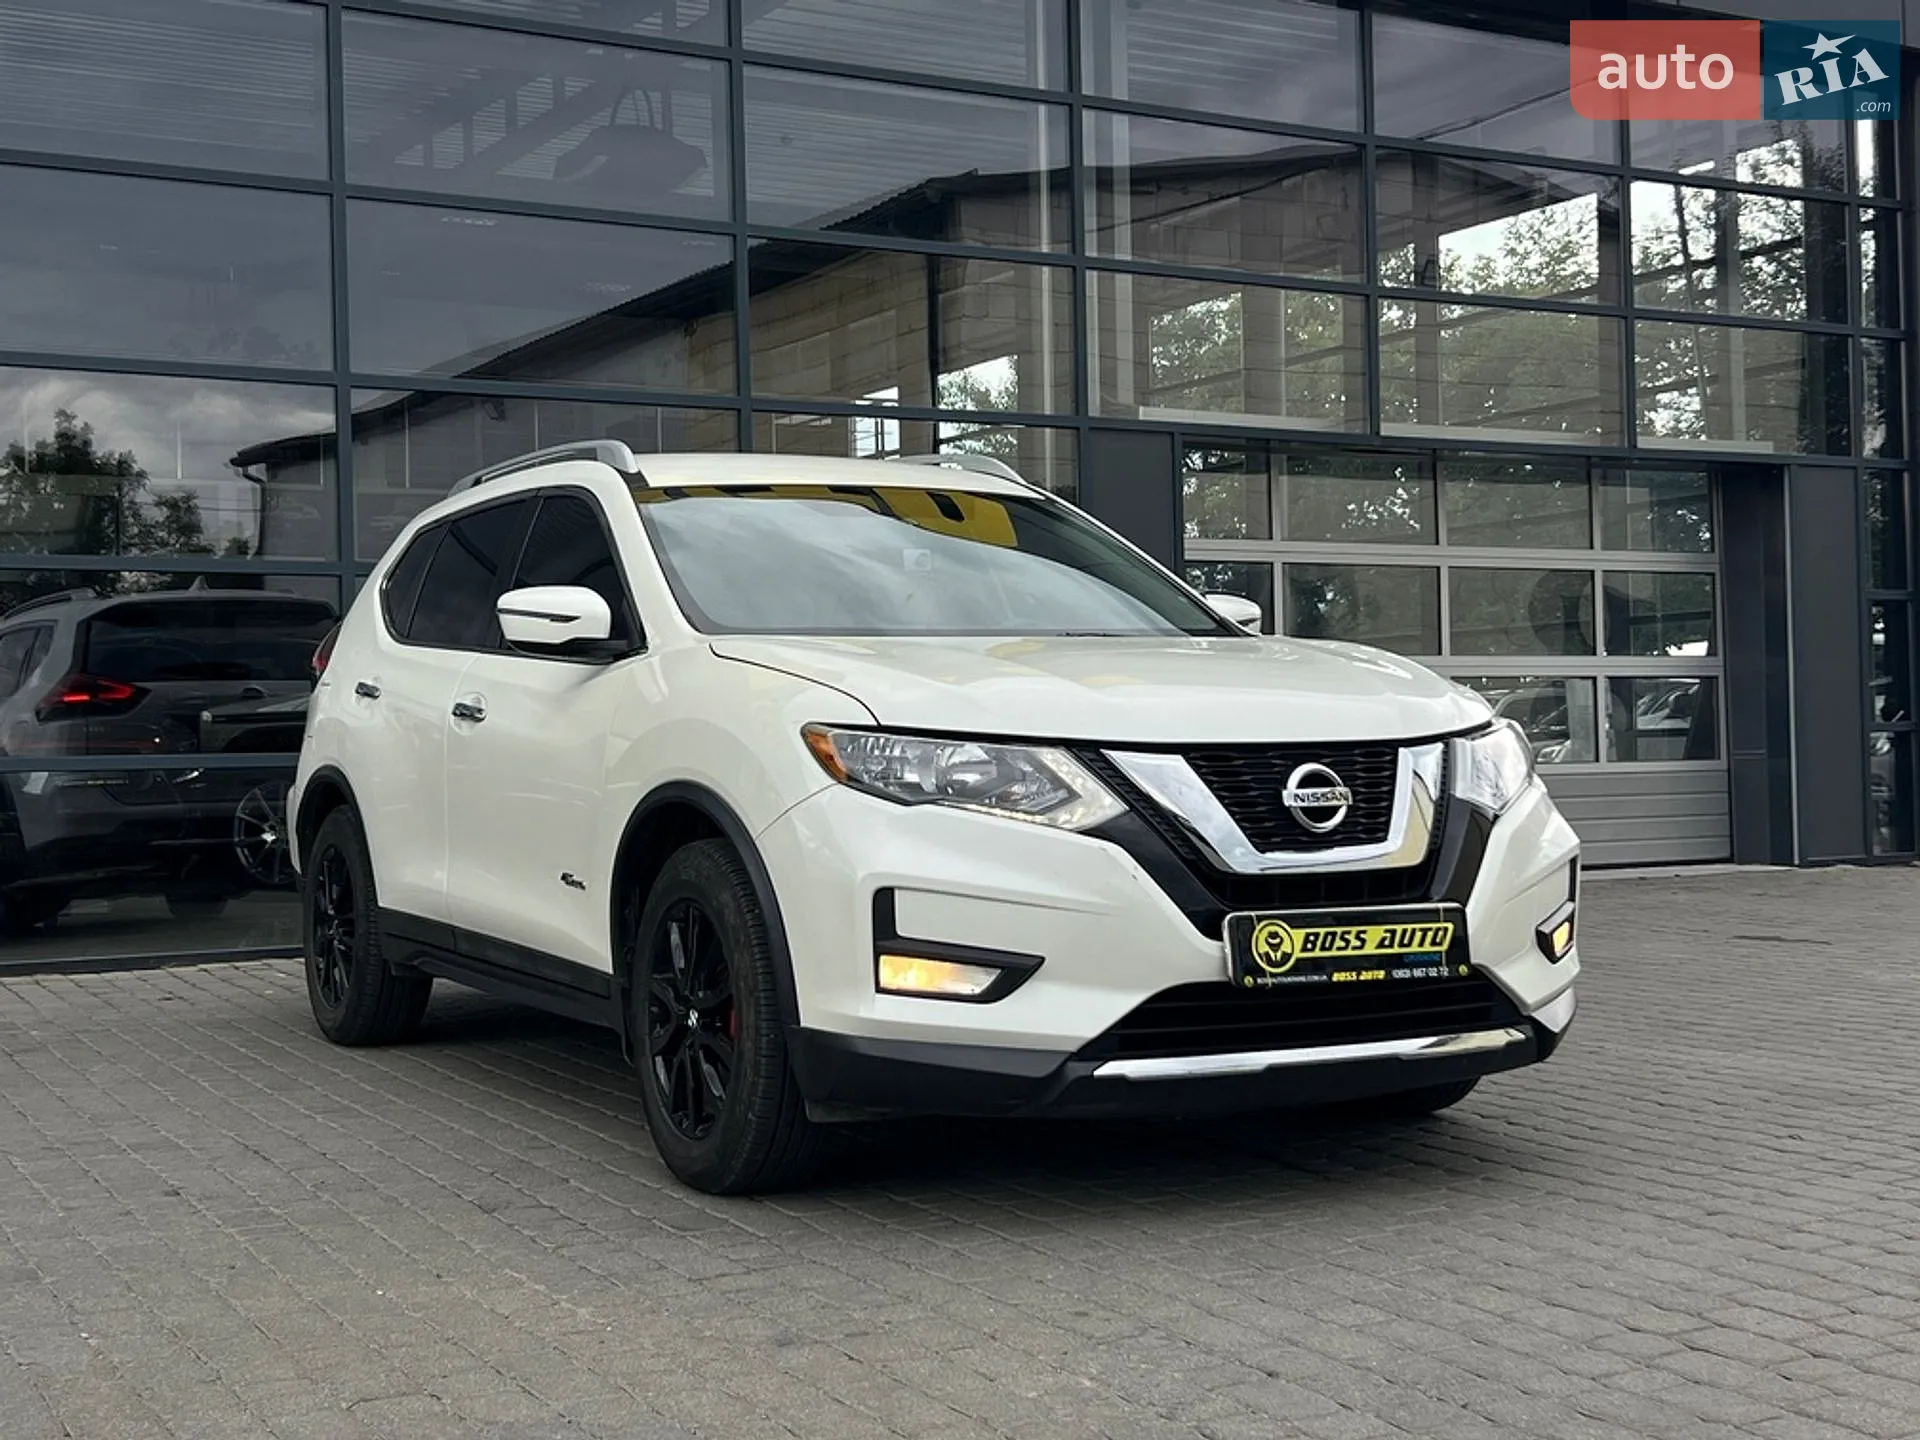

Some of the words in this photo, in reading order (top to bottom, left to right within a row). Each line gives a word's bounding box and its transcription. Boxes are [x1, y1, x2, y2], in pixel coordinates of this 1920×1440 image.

[1293, 790, 1350, 803] NISSAN
[1300, 930, 1367, 953] BOSS
[1375, 926, 1448, 950] AUTO
[1331, 971, 1357, 982] BOSS
